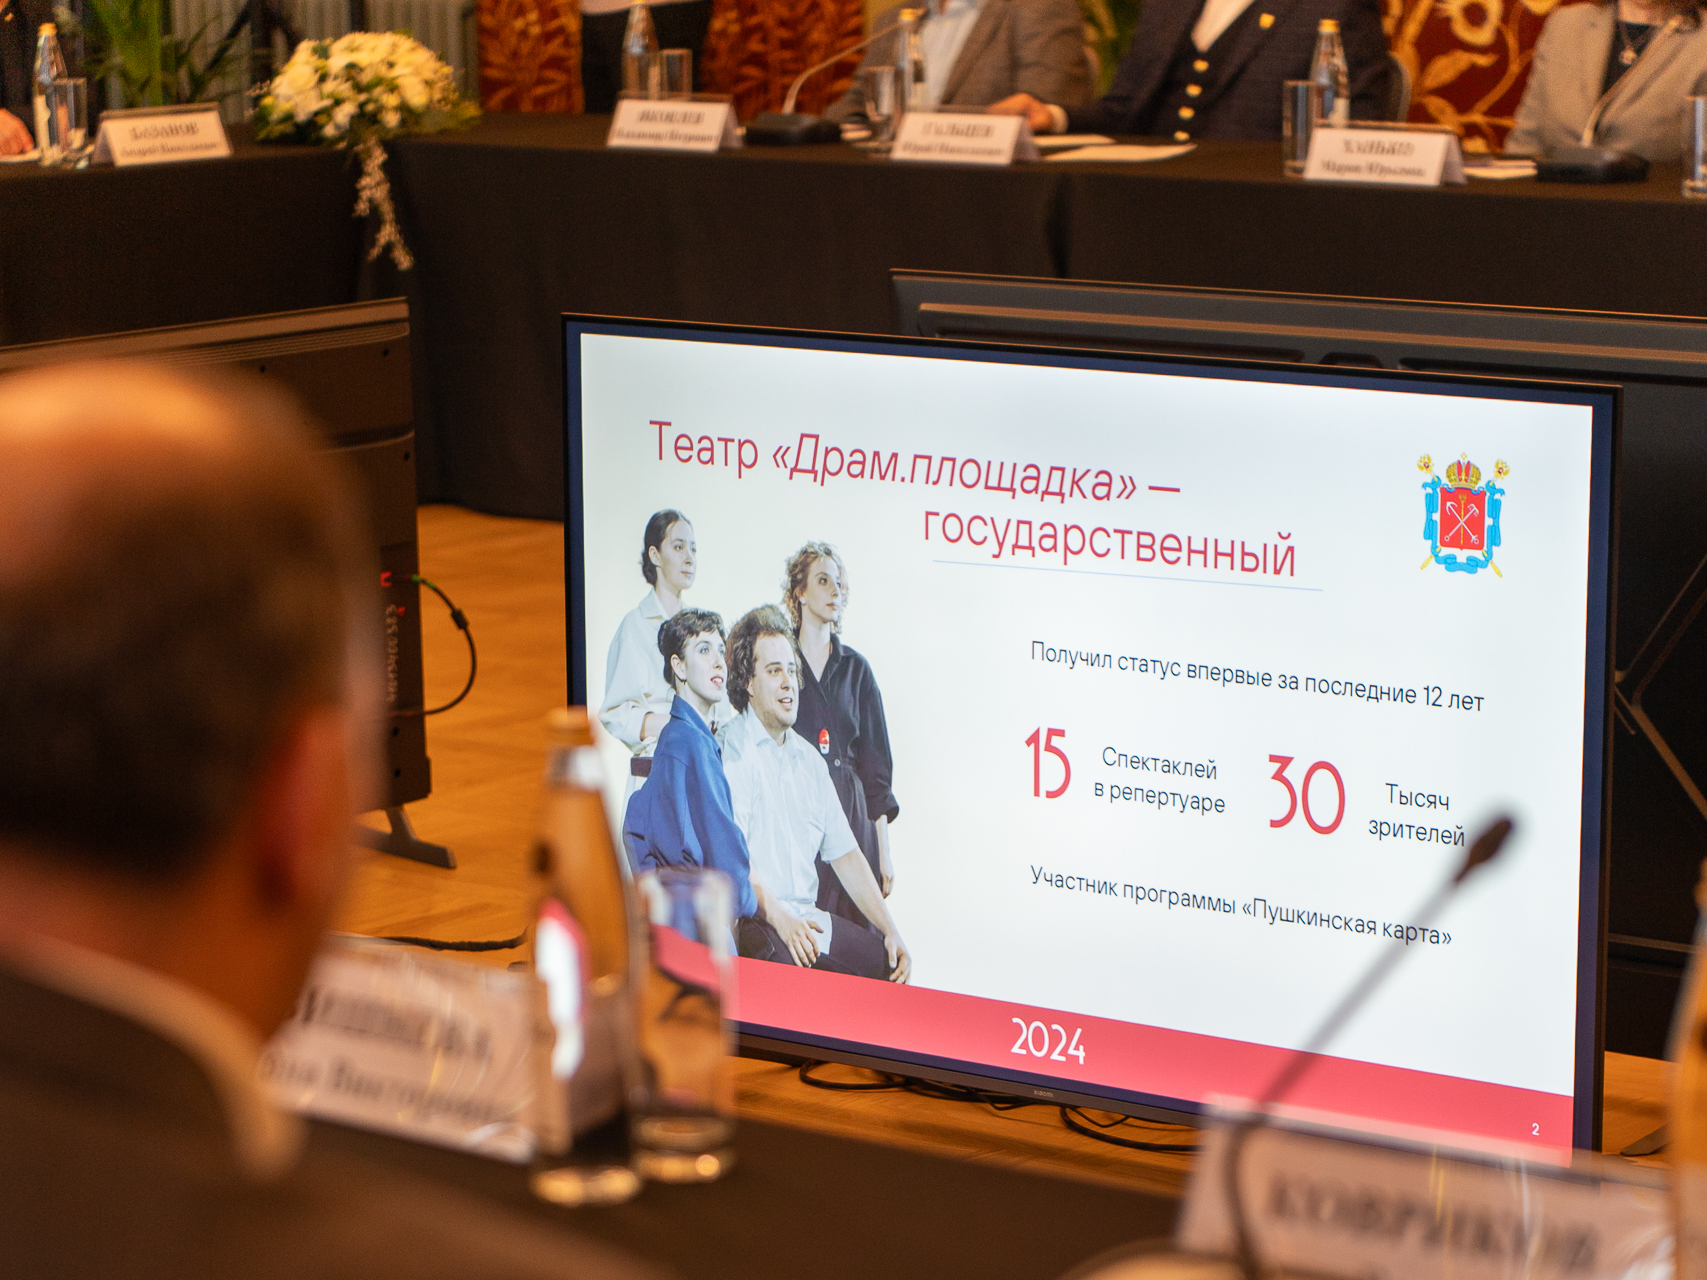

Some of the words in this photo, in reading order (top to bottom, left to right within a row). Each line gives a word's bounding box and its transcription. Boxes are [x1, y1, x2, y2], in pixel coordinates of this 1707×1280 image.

[649, 420, 758, 479] Театр
[772, 432, 1137, 504] «Драм.площадка»
[924, 510, 1295, 578] государственный
[1031, 640, 1113, 670] Получил
[1117, 655, 1182, 681] статус
[1186, 663, 1273, 688] впервые
[1277, 673, 1299, 691] за
[1305, 676, 1418, 704] последние
[1422, 684, 1443, 708] 12
[1447, 693, 1485, 712] лет
[1024, 726, 1072, 800] 15
[1102, 746, 1218, 780] Спектаклей
[1094, 781, 1105, 797] в
[1109, 784, 1226, 817] репертуаре
[1268, 753, 1346, 836] 30
[1385, 782, 1450, 811] Тысяч
[1368, 819, 1466, 848] зрителей
[1030, 864, 1119, 897] Участник
[1123, 883, 1236, 915] программы
[1241, 897, 1377, 936] «Пушкинская
[1382, 921, 1453, 946] карта»
[1010, 1017, 1086, 1066] 2024
[1531, 1122, 1540, 1136] 2
